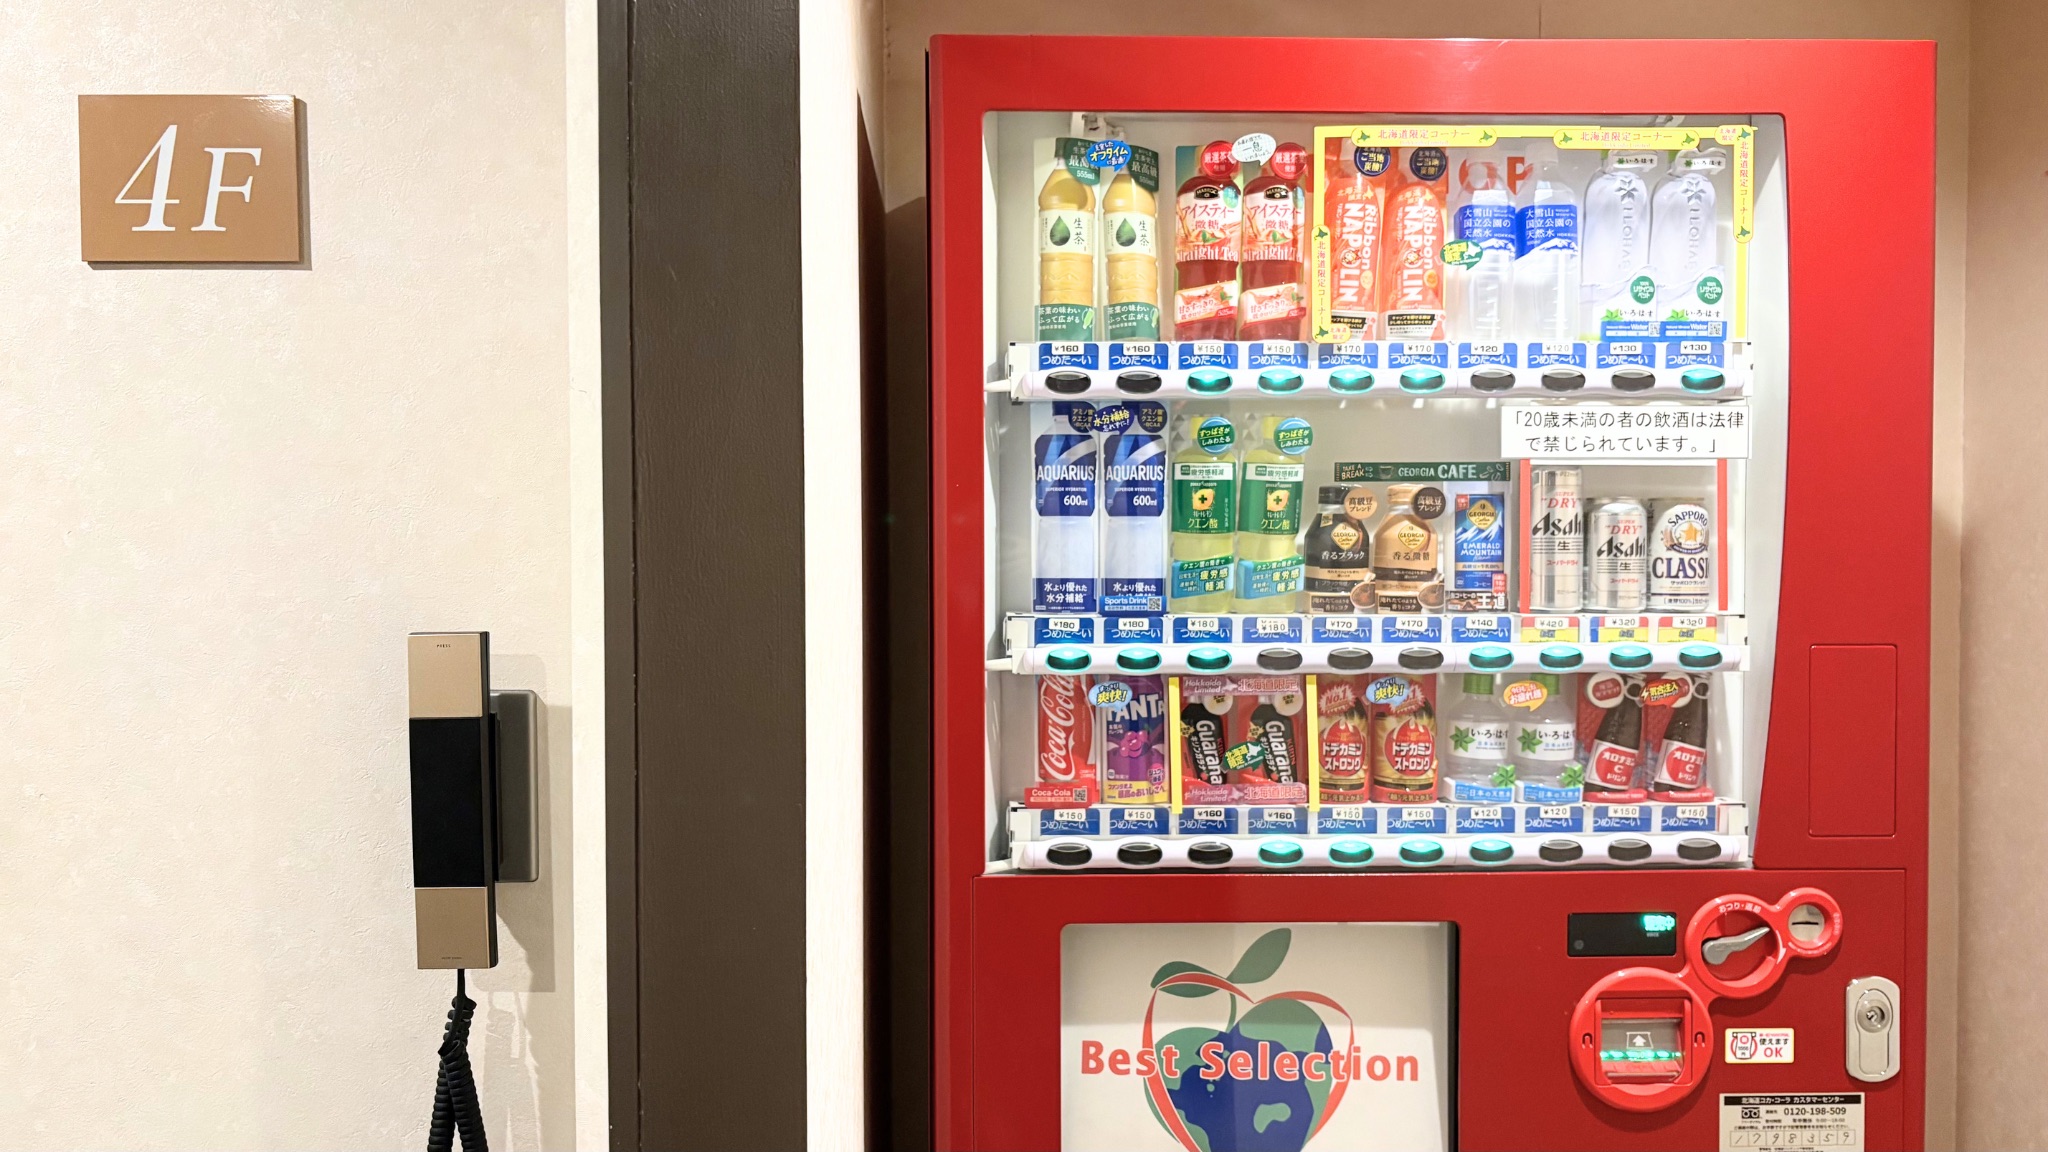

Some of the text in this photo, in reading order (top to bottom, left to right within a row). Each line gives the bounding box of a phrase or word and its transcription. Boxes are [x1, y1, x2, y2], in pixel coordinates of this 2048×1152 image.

[1377, 129, 1471, 139] 北海道限定コーナー
[1580, 132, 1673, 141] 北海道限定コーナー
[1090, 148, 1128, 162] オフタイム
[115, 124, 262, 231] 4F
[1739, 141, 1749, 225] 北海道限定コーナー
[1182, 203, 1235, 219] アイスティー
[1250, 203, 1301, 219] アイスティー
[1463, 207, 1492, 218] 大雪山
[1525, 207, 1555, 218] 大雪山
[1195, 219, 1219, 230] 微糖
[1265, 220, 1289, 230] 微糖
[1463, 218, 1511, 228] 国立公園の
[1525, 218, 1573, 229] 国立公園の
[1073, 217, 1085, 245] 生茶
[1138, 220, 1150, 247] 生茶
[1361, 203, 1379, 270] Ribbon
[1463, 228, 1492, 238] 天然水
[1526, 228, 1555, 239] 天然水
[1422, 205, 1439, 270] Ribbon
[1221, 246, 1238, 261] Tea
[1317, 241, 1326, 324] 北海道限定コーナー
[1054, 345, 1079, 353] ¥160
[1125, 345, 1151, 353] ¥160
[1197, 344, 1222, 354] ¥150
[1266, 344, 1292, 354] ¥150
[1336, 345, 1361, 353] ¥170
[1408, 345, 1432, 353] ¥170
[1473, 345, 1498, 353] ¥120
[1546, 344, 1570, 353] ¥120
[1613, 344, 1637, 352] ¥130
[1683, 343, 1708, 351] ¥130
[1093, 409, 1130, 427] 水分補給
[1515, 410, 1744, 429] 「20歳未満の者の飲酒は法律
[1525, 434, 1718, 453] で禁じられています。」
[1036, 464, 1095, 481] AQUARIUS
[1105, 464, 1164, 481] AQUARIUS
[1341, 469, 1365, 480] BREAK
[1398, 464, 1477, 479] GEORGIA CAFE
[1063, 495, 1088, 506] 600ml
[1132, 495, 1157, 506] 600ml
[1348, 496, 1374, 506] 高級豆
[1417, 496, 1444, 506] 高級豆
[1349, 505, 1372, 513] ブレンド
[1417, 504, 1442, 513] ブレンド
[1187, 518, 1218, 529] クエン酸
[1667, 510, 1708, 527] SAPPORO
[1261, 519, 1290, 530] クエン酸
[1557, 541, 1571, 551] 生
[1596, 535, 1646, 558] Asahi
[1321, 550, 1365, 560] 香るブラック
[1393, 551, 1430, 561] 香る微糖
[1619, 561, 1632, 571] 生
[1652, 557, 1710, 579] CLASSI
[1199, 567, 1229, 580] 疲労感
[1271, 568, 1300, 581] 疲労感
[1044, 581, 1088, 592] 水より優れた
[1113, 581, 1157, 592] 水より優れた
[1204, 580, 1225, 592] 軽減
[1276, 581, 1297, 592] 軽減
[1046, 593, 1084, 604] 水分補給
[1104, 596, 1147, 605] Sports Drink
[1476, 592, 1507, 610] 王道
[1053, 621, 1075, 629] ¥180
[1122, 620, 1144, 628] ¥180
[1190, 620, 1214, 628] ¥180
[1330, 620, 1353, 629] ¥170
[1401, 619, 1423, 628] ¥170
[1471, 619, 1493, 627] ¥140
[1611, 618, 1636, 627] ¥320
[1679, 617, 1704, 627] ¥320
[1237, 678, 1299, 692] 北海道限定
[1096, 690, 1128, 705] 爽快!
[1325, 687, 1348, 704] No.1
[1374, 684, 1405, 701] 爽快!
[1195, 719, 1224, 785] Guarana
[1265, 720, 1294, 785] Guarana
[1322, 742, 1363, 756] ドデカミン
[1392, 742, 1432, 756] ドデカミン
[1325, 757, 1362, 771] ストロング
[1394, 757, 1430, 771] ストロング
[1602, 751, 1636, 766] オロナミン
[1613, 764, 1625, 773] C
[1685, 764, 1695, 773] C
[1606, 773, 1627, 782] ドリンク
[1678, 773, 1697, 782] ドリンク
[1031, 789, 1071, 797] Coca-Cola
[1191, 787, 1228, 796] Hokkaido
[1244, 786, 1306, 800] 北海道限定
[1058, 811, 1083, 820] ¥150
[1128, 811, 1152, 819] ¥150
[1267, 812, 1292, 820] ¥160
[1335, 810, 1360, 818] ¥150
[1407, 810, 1431, 818] ¥150
[1474, 809, 1498, 817] ¥120
[1612, 807, 1637, 815] ¥150
[1682, 808, 1707, 817] ¥160
[1759, 1038, 1789, 1046] 使えます
[1763, 1047, 1783, 1058] OK
[1080, 1039, 1420, 1082] Best Selection
[1793, 1096, 1845, 1104] カスタマーセンター
[1783, 1107, 1847, 1116] 0120-198-509
